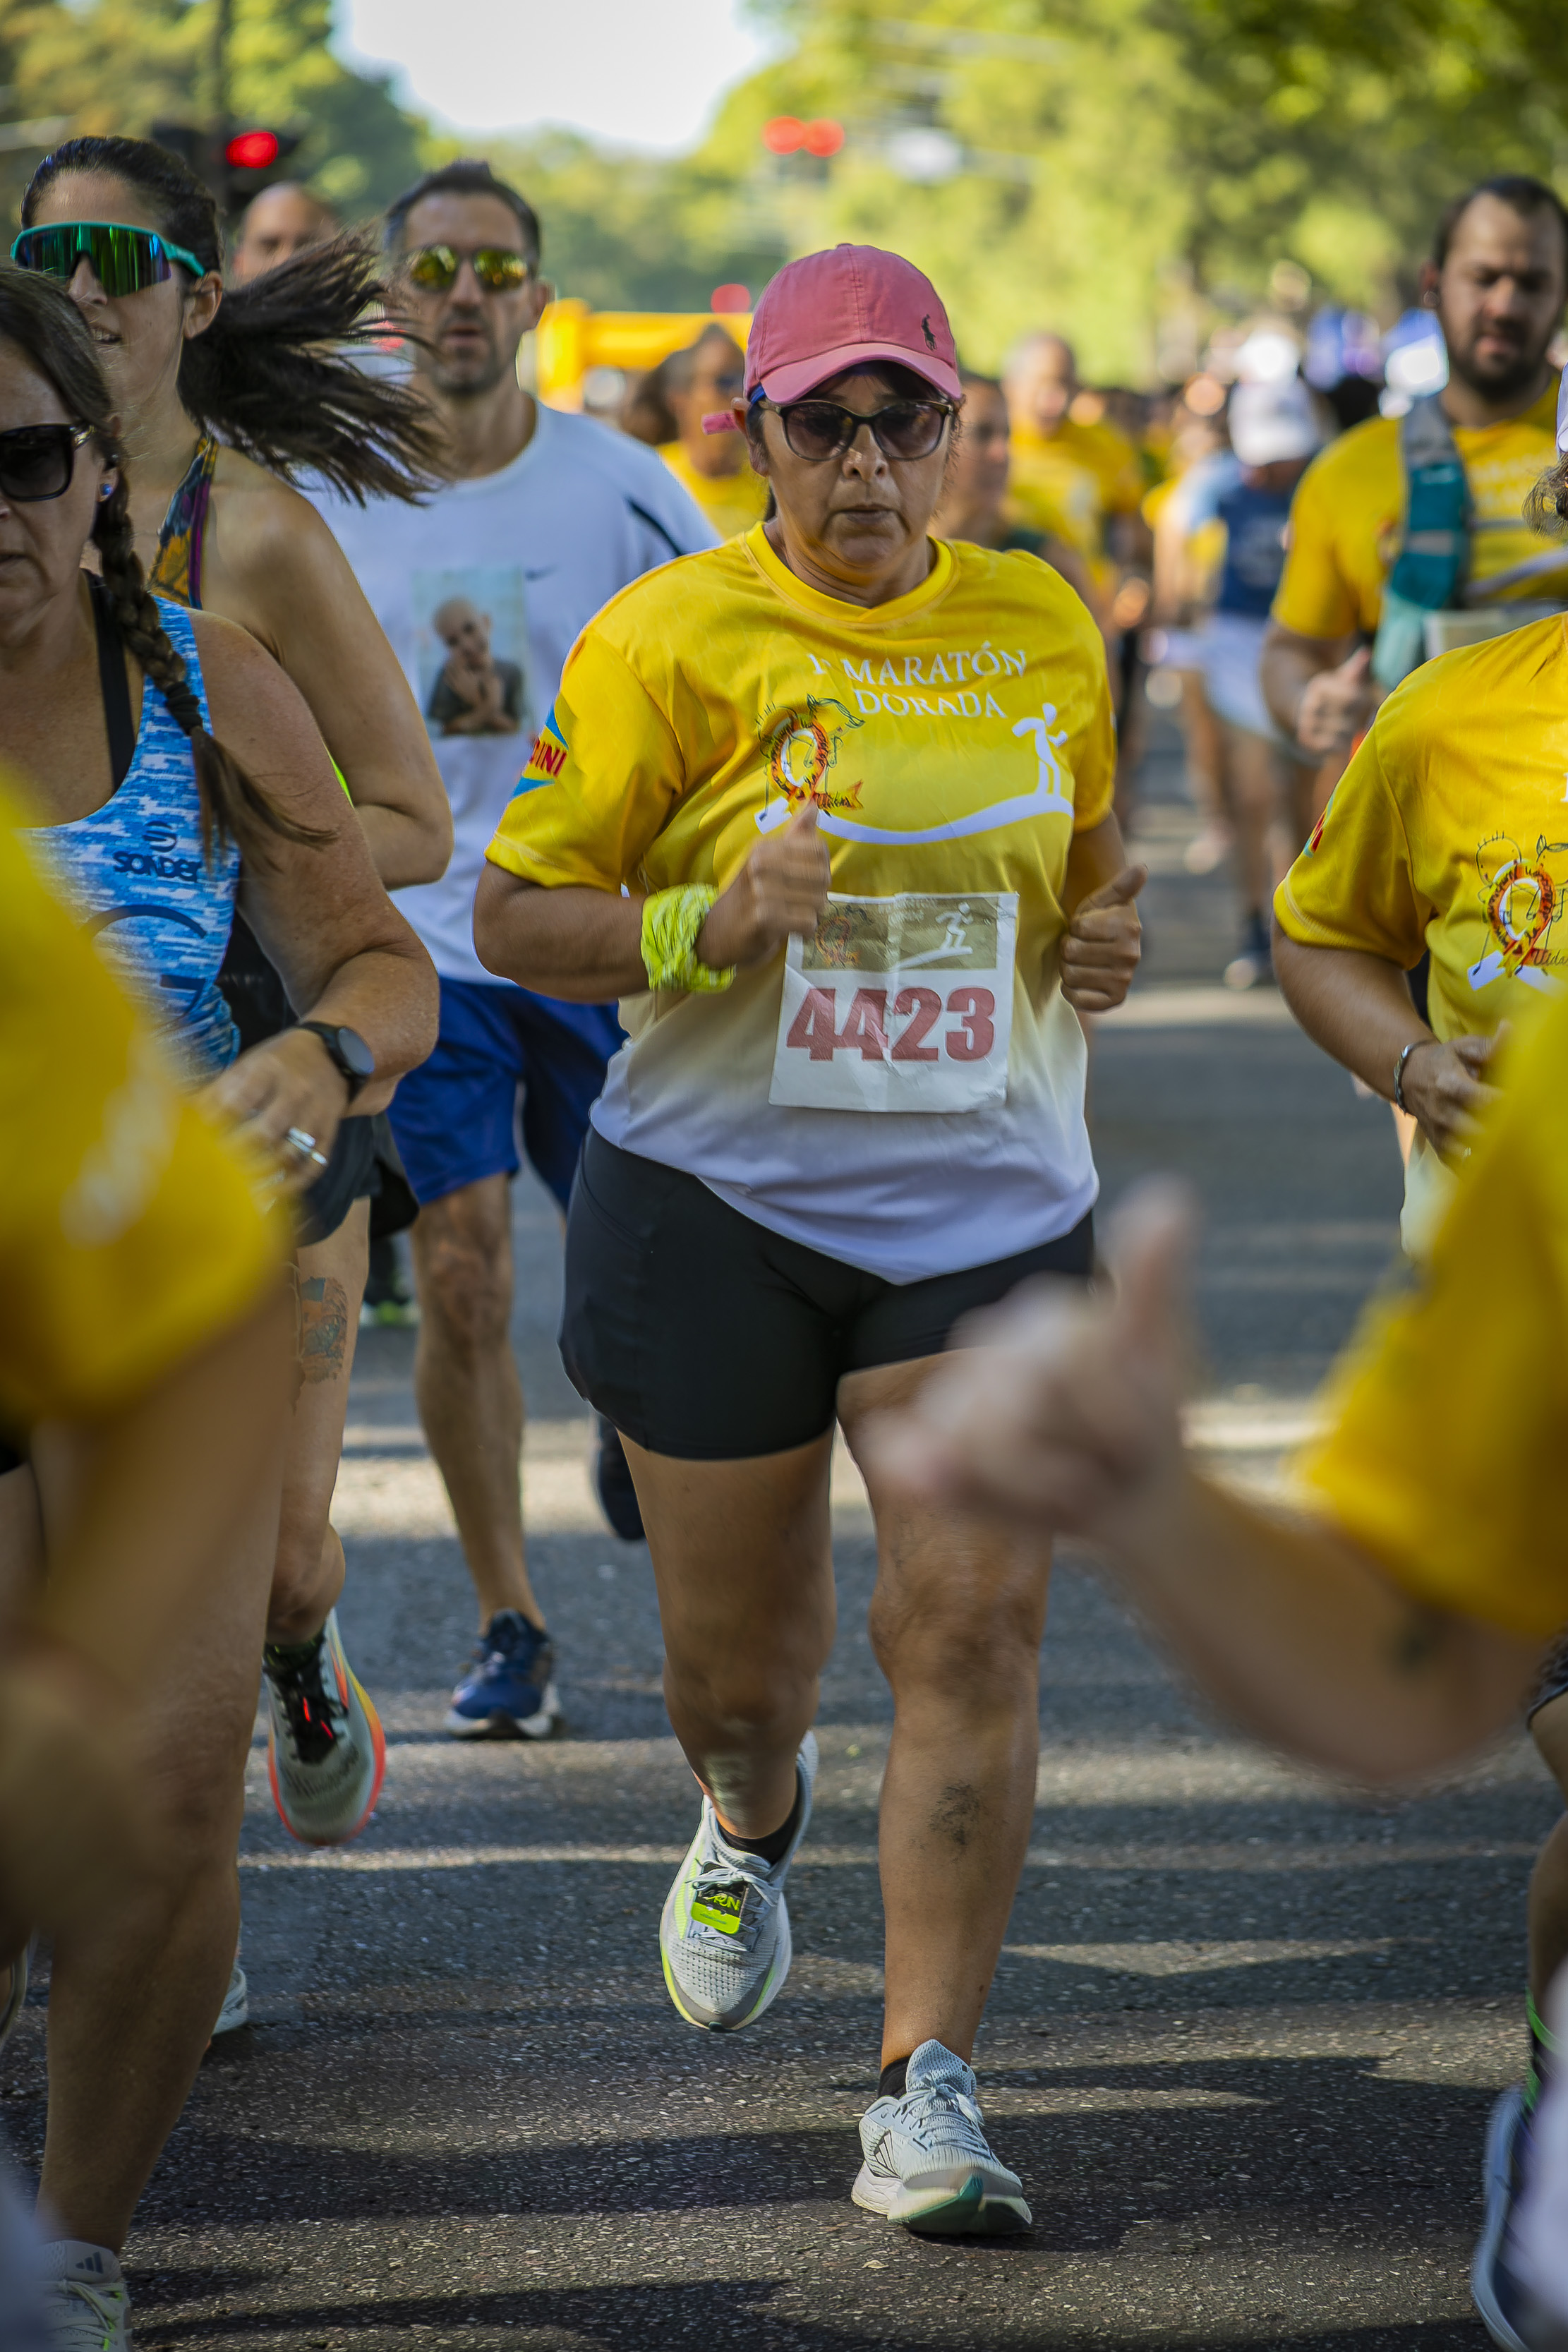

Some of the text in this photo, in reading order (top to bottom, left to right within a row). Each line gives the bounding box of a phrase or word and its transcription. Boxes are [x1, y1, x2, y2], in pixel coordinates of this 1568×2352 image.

[840, 640, 1027, 686] MARATÓN
[852, 689, 1008, 718] DORADA
[786, 985, 996, 1062] 4423
